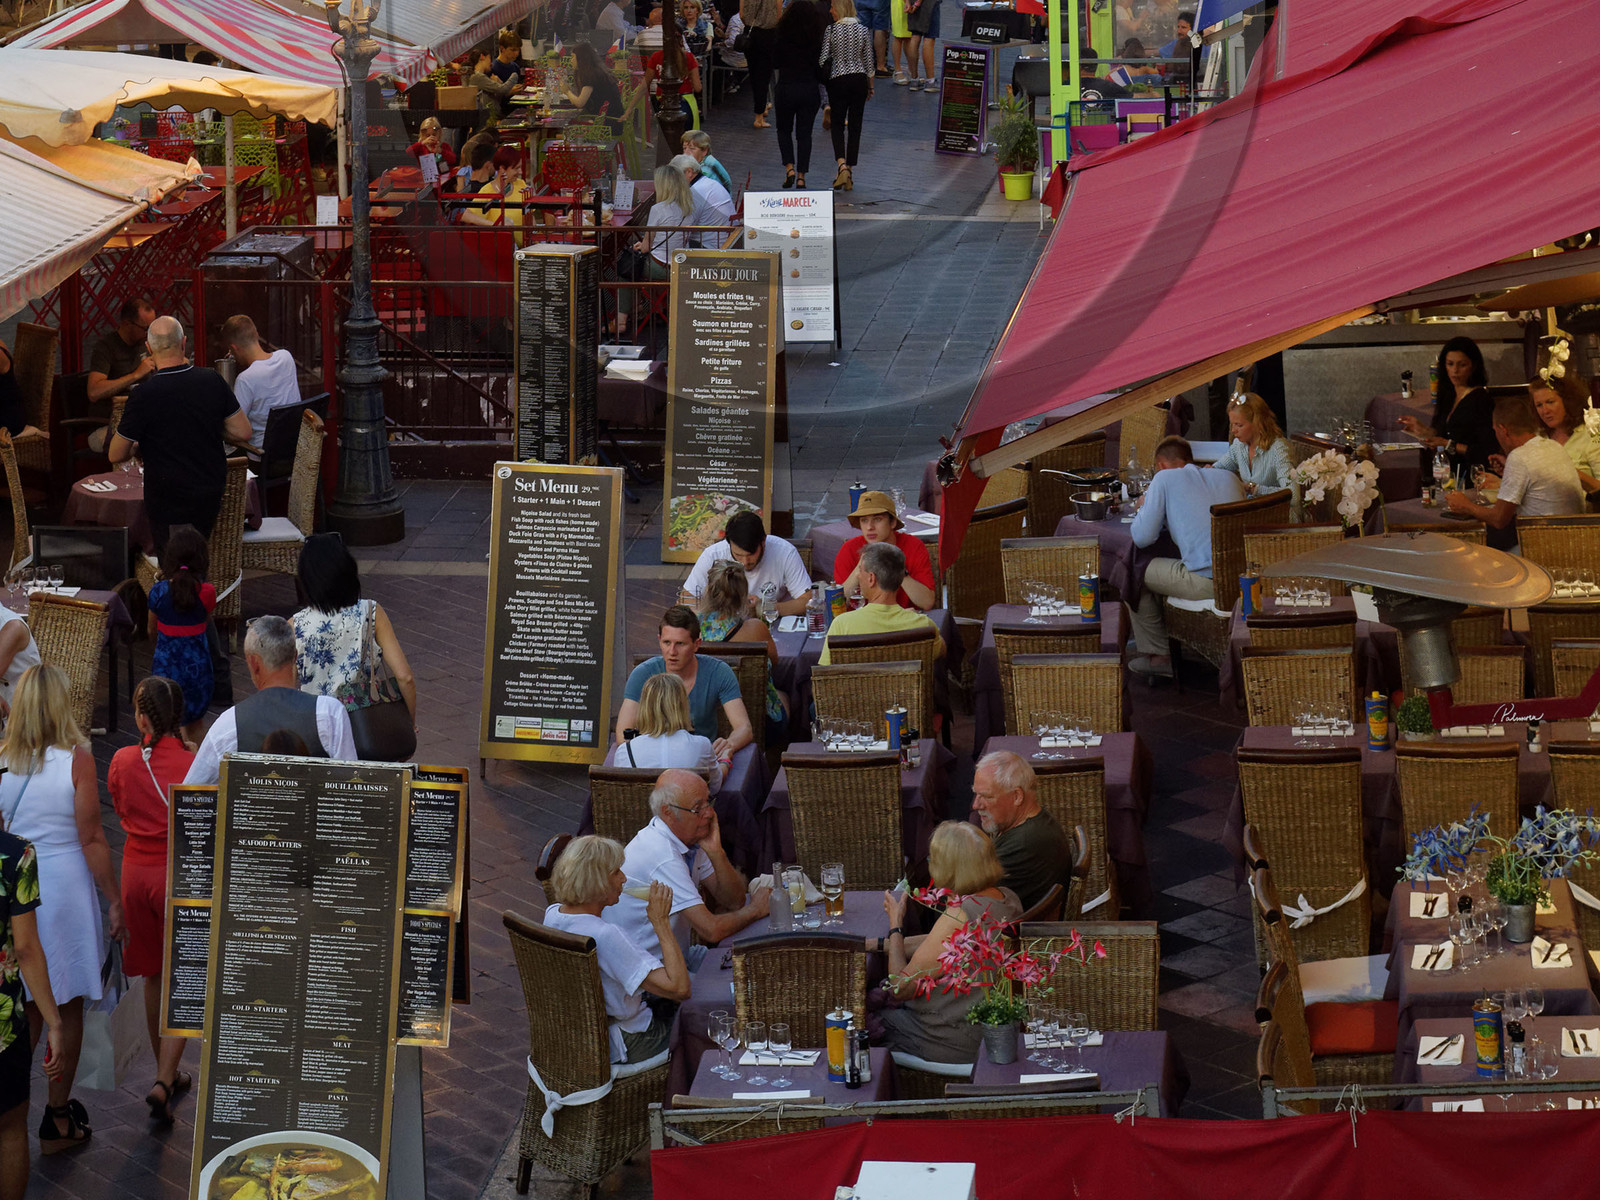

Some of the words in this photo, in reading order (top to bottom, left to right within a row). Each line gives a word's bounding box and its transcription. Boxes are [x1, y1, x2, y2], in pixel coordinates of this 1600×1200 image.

[976, 26, 1001, 37] OPEN
[946, 49, 960, 59] Pop
[782, 196, 812, 207] MARCEL
[690, 268, 718, 280] PLATS
[720, 269, 732, 280] DU
[735, 270, 758, 281] JOUR
[695, 338, 724, 346] Sardines
[725, 339, 750, 348] grillées
[701, 357, 720, 365] Petite
[691, 406, 720, 414] Salades
[721, 406, 749, 416] géantes
[707, 446, 730, 454] Océane
[698, 476, 738, 484] Végétarienne
[514, 478, 536, 492] Set
[539, 478, 579, 493] Menu
[517, 496, 538, 504] Starter
[273, 779, 299, 788] NIÇOIS
[324, 782, 389, 792] BOUILLABAISSES
[414, 791, 425, 799] Set
[425, 791, 445, 800] Menu
[238, 839, 269, 847] SEAFOOD
[269, 840, 302, 849] PLATTERS
[190, 909, 209, 917] Menu
[232, 931, 260, 939] SHELLFISH
[253, 1006, 288, 1014] STARTERS
[332, 1041, 352, 1049] MEAT
[246, 1076, 281, 1085] STARTERS
